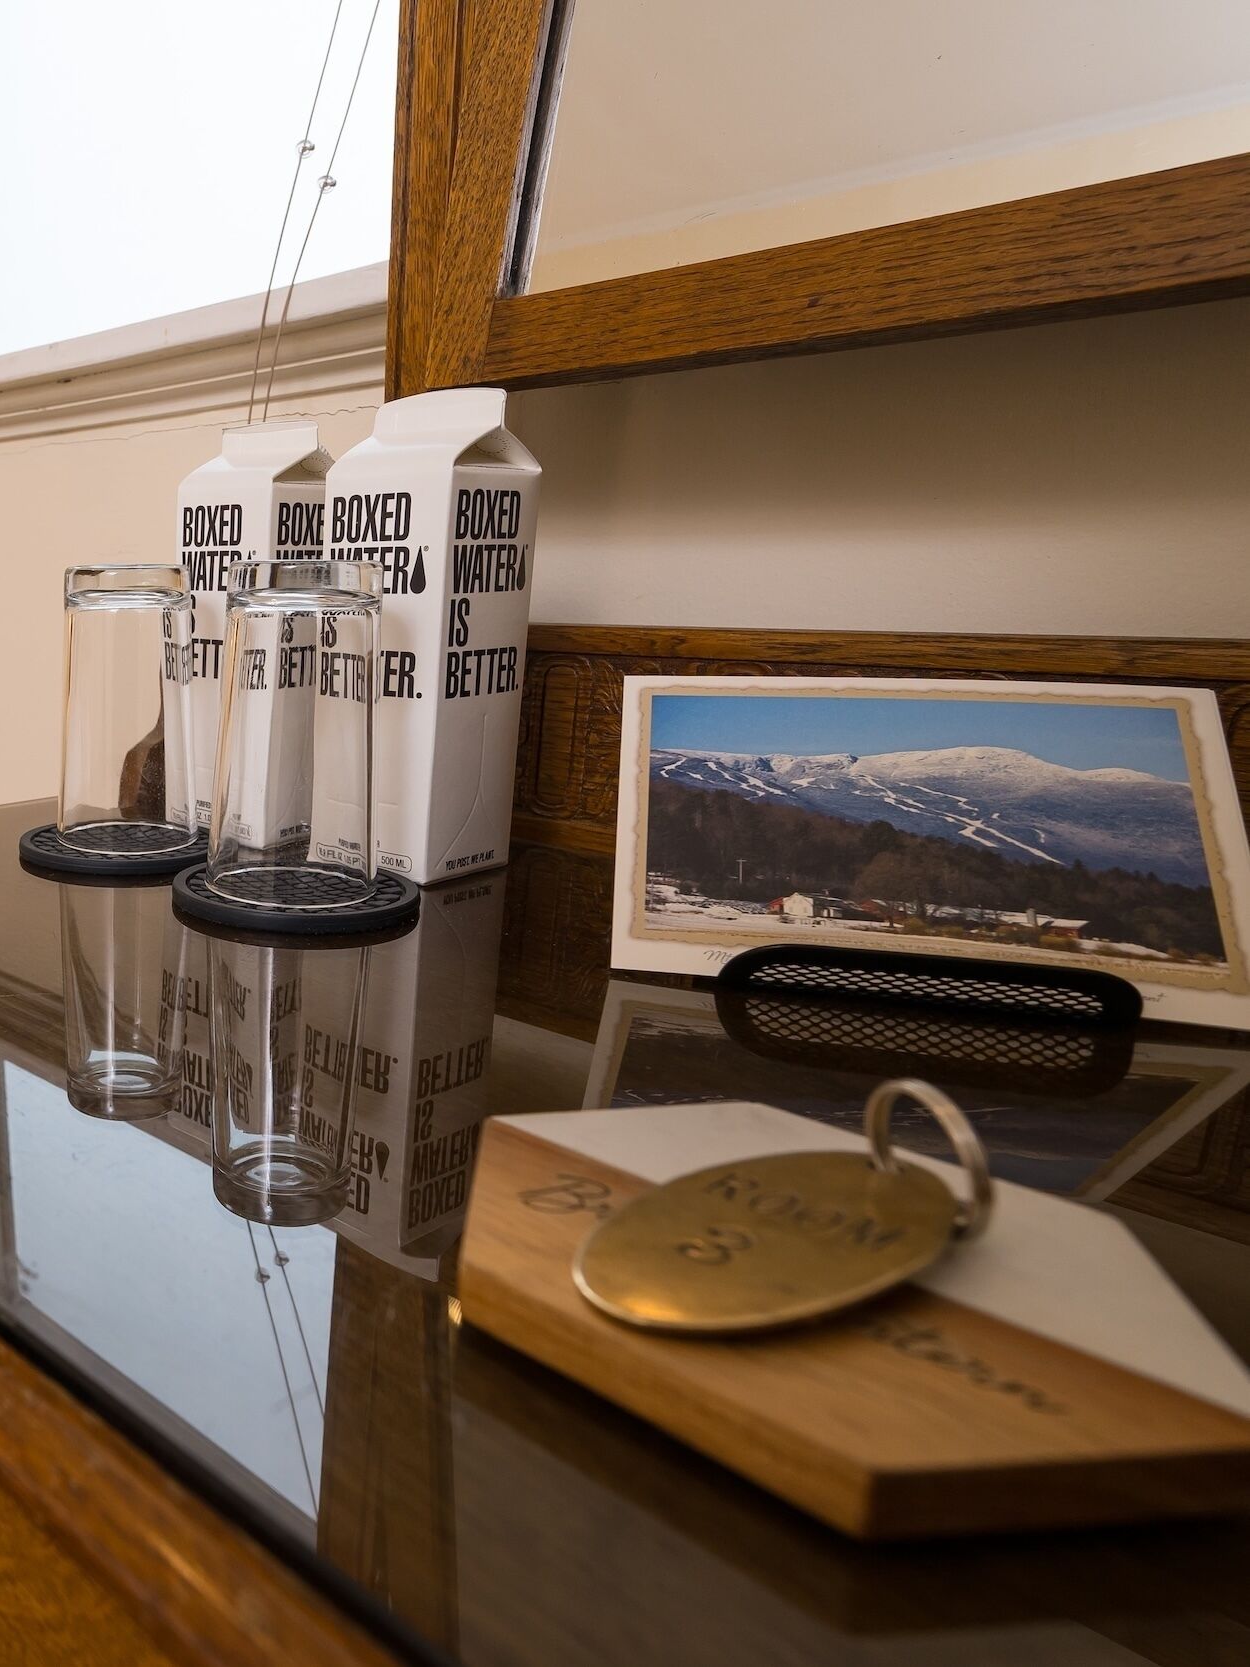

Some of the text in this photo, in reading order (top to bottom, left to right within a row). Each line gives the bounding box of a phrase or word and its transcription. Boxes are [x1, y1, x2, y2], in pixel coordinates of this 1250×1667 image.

[182, 504, 243, 547] BOXED
[276, 502, 325, 546] BOXE
[331, 492, 412, 543] BOXED
[455, 489, 521, 540] BOXED
[453, 544, 518, 593] WATER
[448, 598, 471, 647] IS
[445, 647, 518, 699] BETTER.
[381, 855, 395, 866] 500
[395, 858, 407, 869] ML
[445, 860, 456, 871] YOU
[704, 1173, 908, 1252] ROOM
